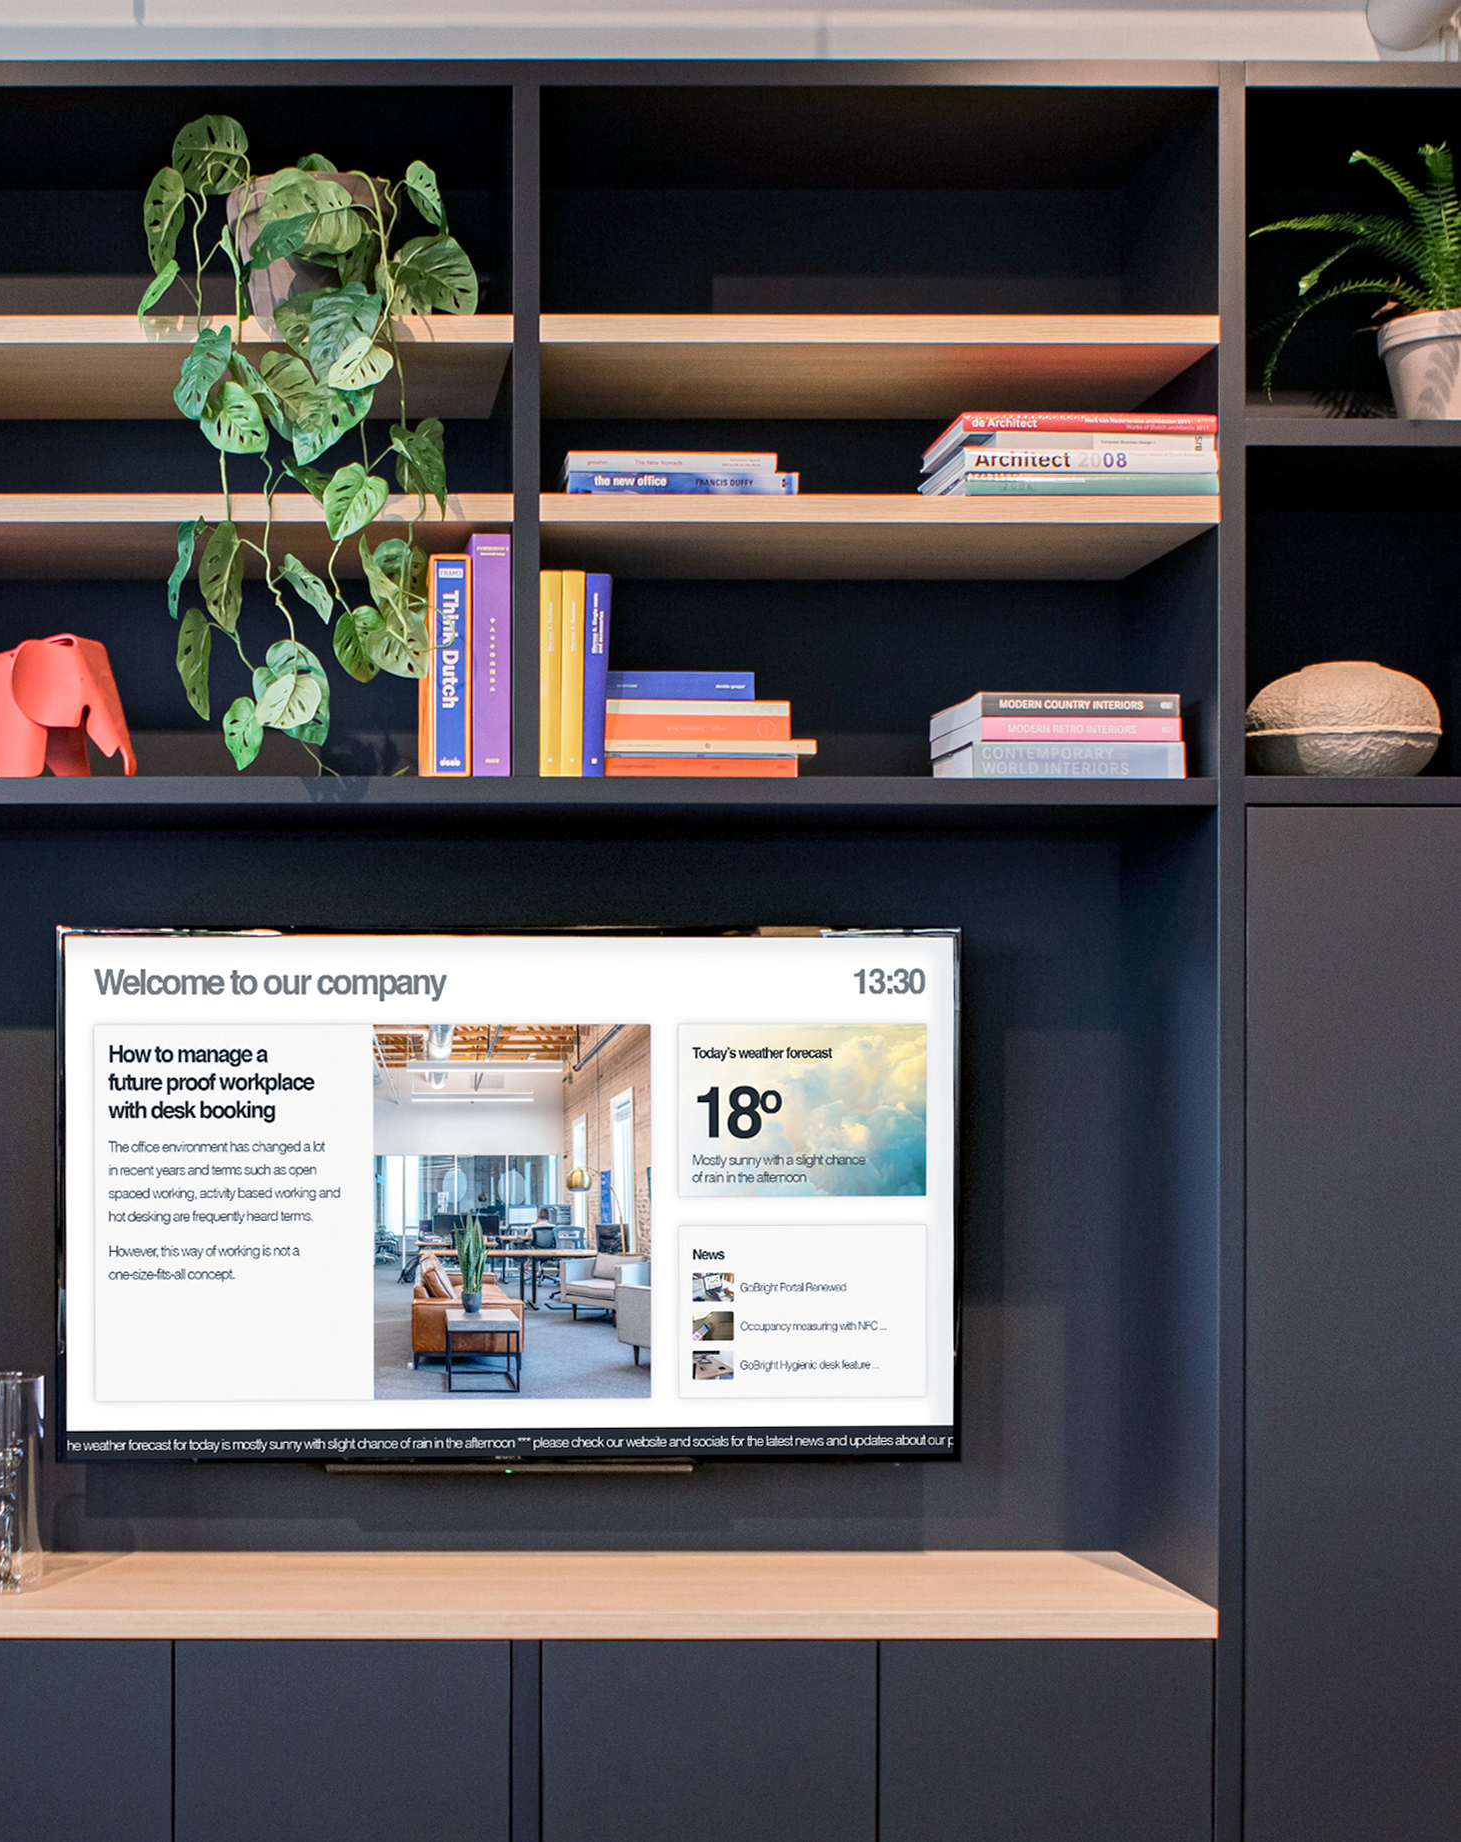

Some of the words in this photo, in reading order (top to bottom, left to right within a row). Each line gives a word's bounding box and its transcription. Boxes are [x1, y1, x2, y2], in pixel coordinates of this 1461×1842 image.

[971, 418, 985, 428] de
[987, 418, 1037, 429] Architect
[1078, 453, 1127, 468] 2008
[594, 475, 611, 487] the
[613, 477, 636, 487] new
[637, 475, 667, 487] office
[695, 478, 728, 488] FRANCIS
[730, 479, 753, 487] DUFFY
[442, 590, 460, 645] Think
[442, 649, 460, 710] Dutch
[999, 700, 1042, 709] MODERN
[1044, 700, 1091, 709] COUNTRY
[1093, 701, 1144, 710] INTERIORS
[1008, 724, 1050, 734] MODERN
[1053, 724, 1084, 733] RETRO
[1087, 724, 1137, 735] INTERIORS
[981, 747, 1113, 760] CONTEMPORARY
[982, 762, 1037, 775] WORLD
[1044, 762, 1130, 775] INTERIORS
[94, 969, 225, 995] Welcome
[230, 970, 258, 995] to
[264, 975, 312, 995] our
[317, 975, 447, 1002] company
[854, 968, 925, 994] 13:30
[109, 1045, 152, 1063] How
[155, 1046, 174, 1063] to
[178, 1049, 253, 1067] manage
[257, 1049, 268, 1062] a
[692, 1047, 736, 1061] Today's
[739, 1047, 784, 1058] weather
[786, 1047, 832, 1058] forecast
[108, 1073, 162, 1091] future
[167, 1073, 216, 1095] proof
[219, 1073, 315, 1095] workplace
[108, 1101, 147, 1118] with
[151, 1101, 196, 1119] desk
[200, 1101, 275, 1123] booking
[108, 1141, 129, 1153] The
[131, 1141, 160, 1153] office
[162, 1141, 228, 1152] environment
[230, 1141, 250, 1152] has
[252, 1141, 301, 1155] changed
[313, 1141, 325, 1152] lot
[693, 1154, 727, 1168] Mostly
[729, 1157, 762, 1168] sunny
[763, 1154, 784, 1165] with
[796, 1154, 823, 1168] slight
[825, 1153, 866, 1166] chance
[109, 1164, 118, 1175] in
[120, 1166, 154, 1176] recent
[156, 1167, 186, 1178] years
[188, 1164, 209, 1175] and
[212, 1166, 242, 1175] terms
[244, 1164, 271, 1175] such
[273, 1167, 286, 1175] as
[289, 1167, 317, 1177] open
[692, 1171, 703, 1183] of
[705, 1172, 724, 1183] rain
[726, 1171, 736, 1183] in
[738, 1172, 754, 1183] the
[757, 1171, 807, 1183] afternoon
[109, 1188, 150, 1201] spaced
[152, 1188, 197, 1202] working,
[200, 1187, 236, 1201] activity
[238, 1187, 272, 1198] based
[275, 1187, 316, 1201] working
[319, 1187, 340, 1198] and
[109, 1211, 126, 1222] hot
[128, 1211, 171, 1225] desking
[173, 1213, 190, 1222] are
[192, 1211, 245, 1224] frequently
[247, 1211, 278, 1221] heard
[281, 1211, 313, 1221] terms.
[109, 1245, 159, 1258] However,
[161, 1245, 180, 1257] this
[181, 1248, 204, 1259] way
[206, 1245, 216, 1257] of
[218, 1245, 260, 1259] working
[263, 1245, 271, 1256] is
[274, 1246, 290, 1256] not
[693, 1249, 725, 1260] News
[108, 1268, 185, 1280] one-size-fits-all
[188, 1269, 235, 1282] concept.
[740, 1282, 778, 1295] GoBright
[780, 1282, 804, 1292] Portal
[806, 1282, 847, 1292] Renewed
[740, 1321, 791, 1333] Occupancy
[793, 1322, 838, 1333] measuring
[839, 1322, 856, 1330] with
[858, 1320, 878, 1330] NFC
[740, 1360, 778, 1372] GoBright
[780, 1360, 817, 1372] Hygienic
[819, 1360, 840, 1369] desk
[842, 1360, 871, 1369] feature
[83, 1440, 126, 1451] weather
[129, 1439, 171, 1451] forecast
[189, 1439, 220, 1453] today
[233, 1439, 268, 1452] mostly
[269, 1441, 302, 1452] sunny
[304, 1438, 325, 1449] with
[328, 1438, 355, 1452] slight
[357, 1438, 398, 1449] chance
[413, 1437, 432, 1449] rain
[465, 1437, 515, 1448] afternoon
